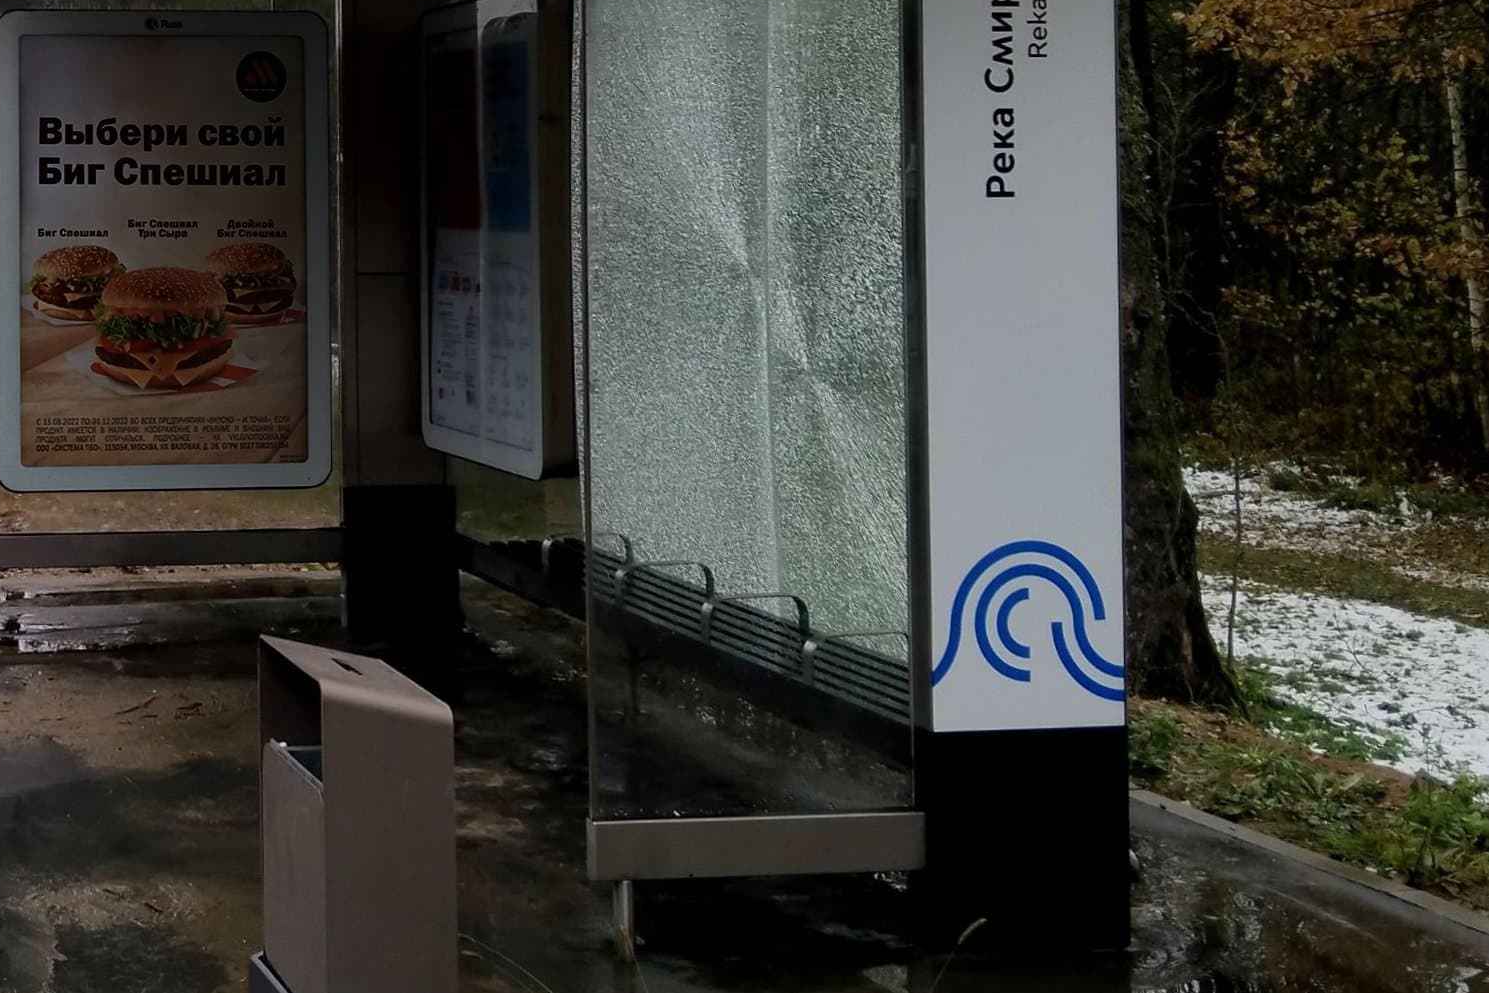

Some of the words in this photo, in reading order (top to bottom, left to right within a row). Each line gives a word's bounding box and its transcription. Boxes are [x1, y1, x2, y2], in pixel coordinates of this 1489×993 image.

[38, 117, 188, 151] Выбери
[197, 116, 286, 146] свой
[984, 106, 1016, 198] Река
[38, 157, 106, 185] Биг
[114, 157, 286, 186] Спешиал
[127, 219, 148, 228] Биг
[149, 219, 198, 228] Спешиал
[227, 219, 274, 229] Двойной
[37, 228, 57, 237] Биг
[59, 228, 109, 237] Спешиал
[137, 229, 157, 239] Три
[158, 229, 188, 239] Сыра
[217, 229, 236, 238] Биг
[238, 229, 288, 238] Спешиал
